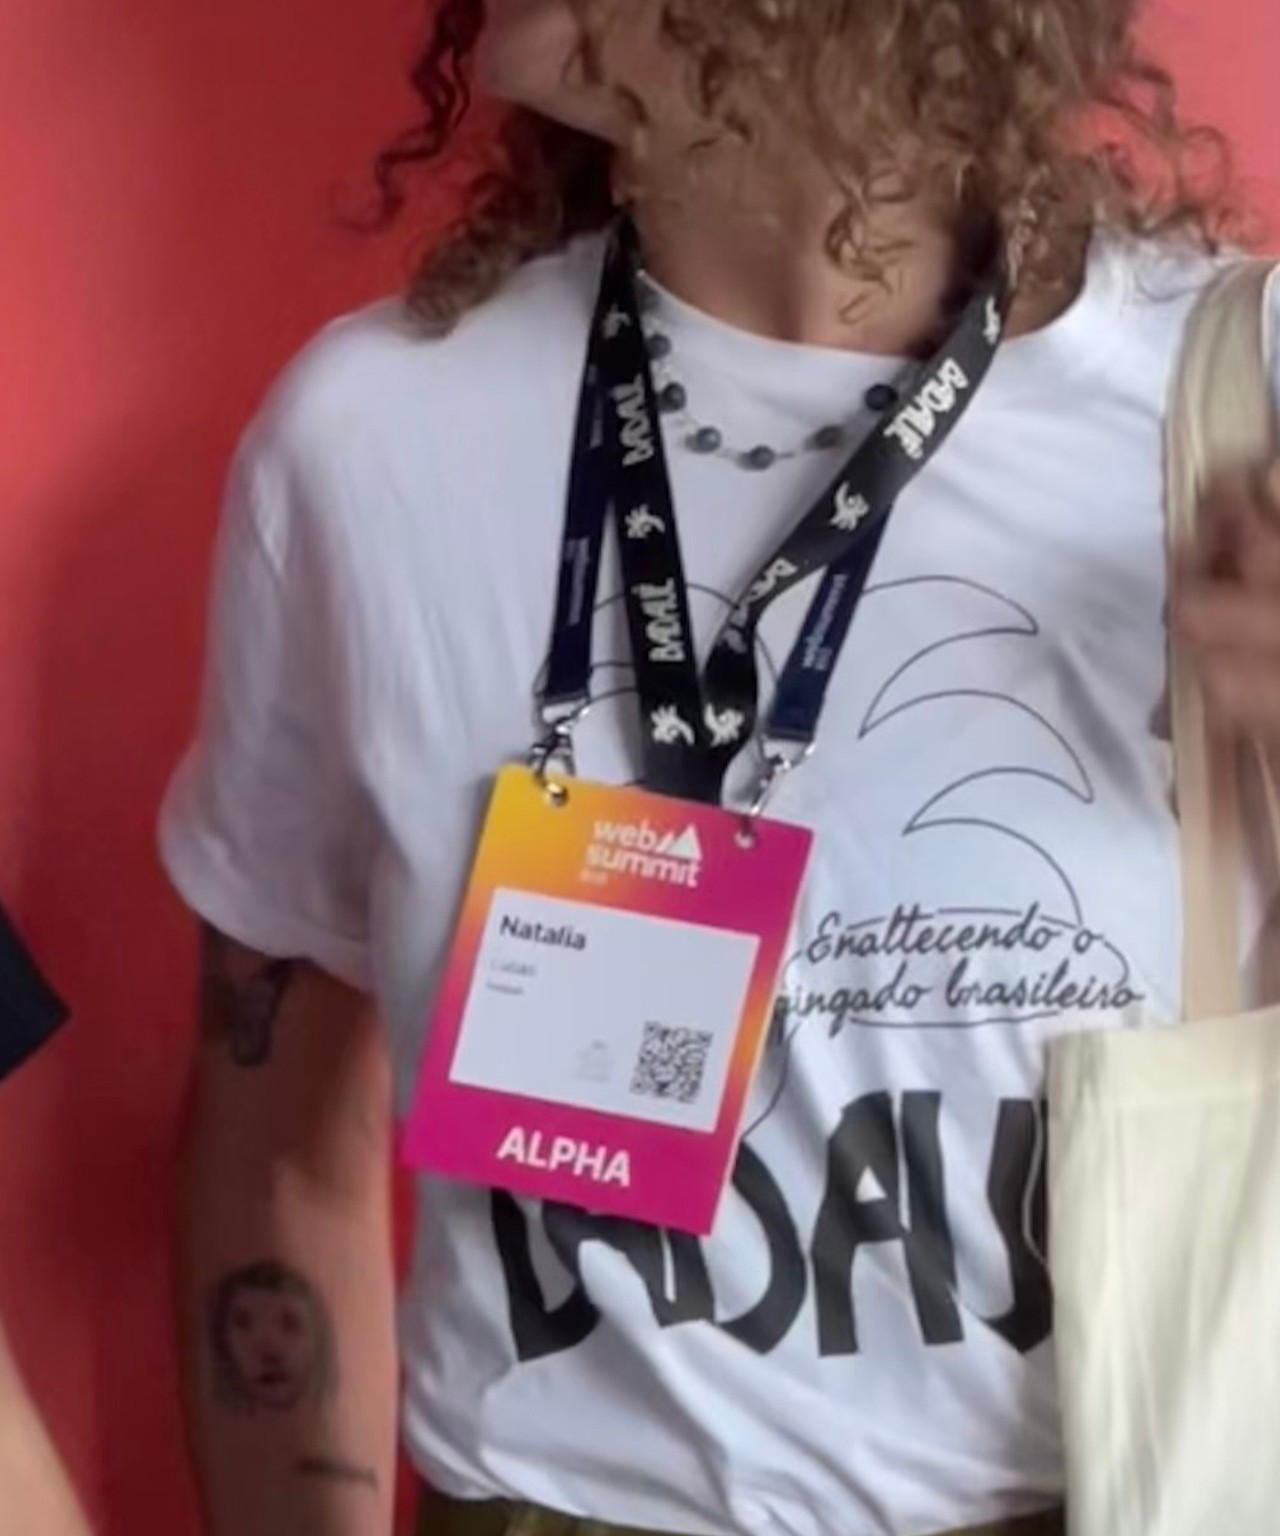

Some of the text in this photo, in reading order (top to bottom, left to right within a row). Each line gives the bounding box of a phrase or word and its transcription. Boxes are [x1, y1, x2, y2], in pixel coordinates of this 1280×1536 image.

[593, 816, 658, 850] web
[585, 842, 700, 888] summit
[500, 915, 586, 951] Natalia
[1074, 928, 1104, 953] o
[946, 956, 1145, 1009] brasileiro
[496, 1126, 632, 1187] ALPHA
